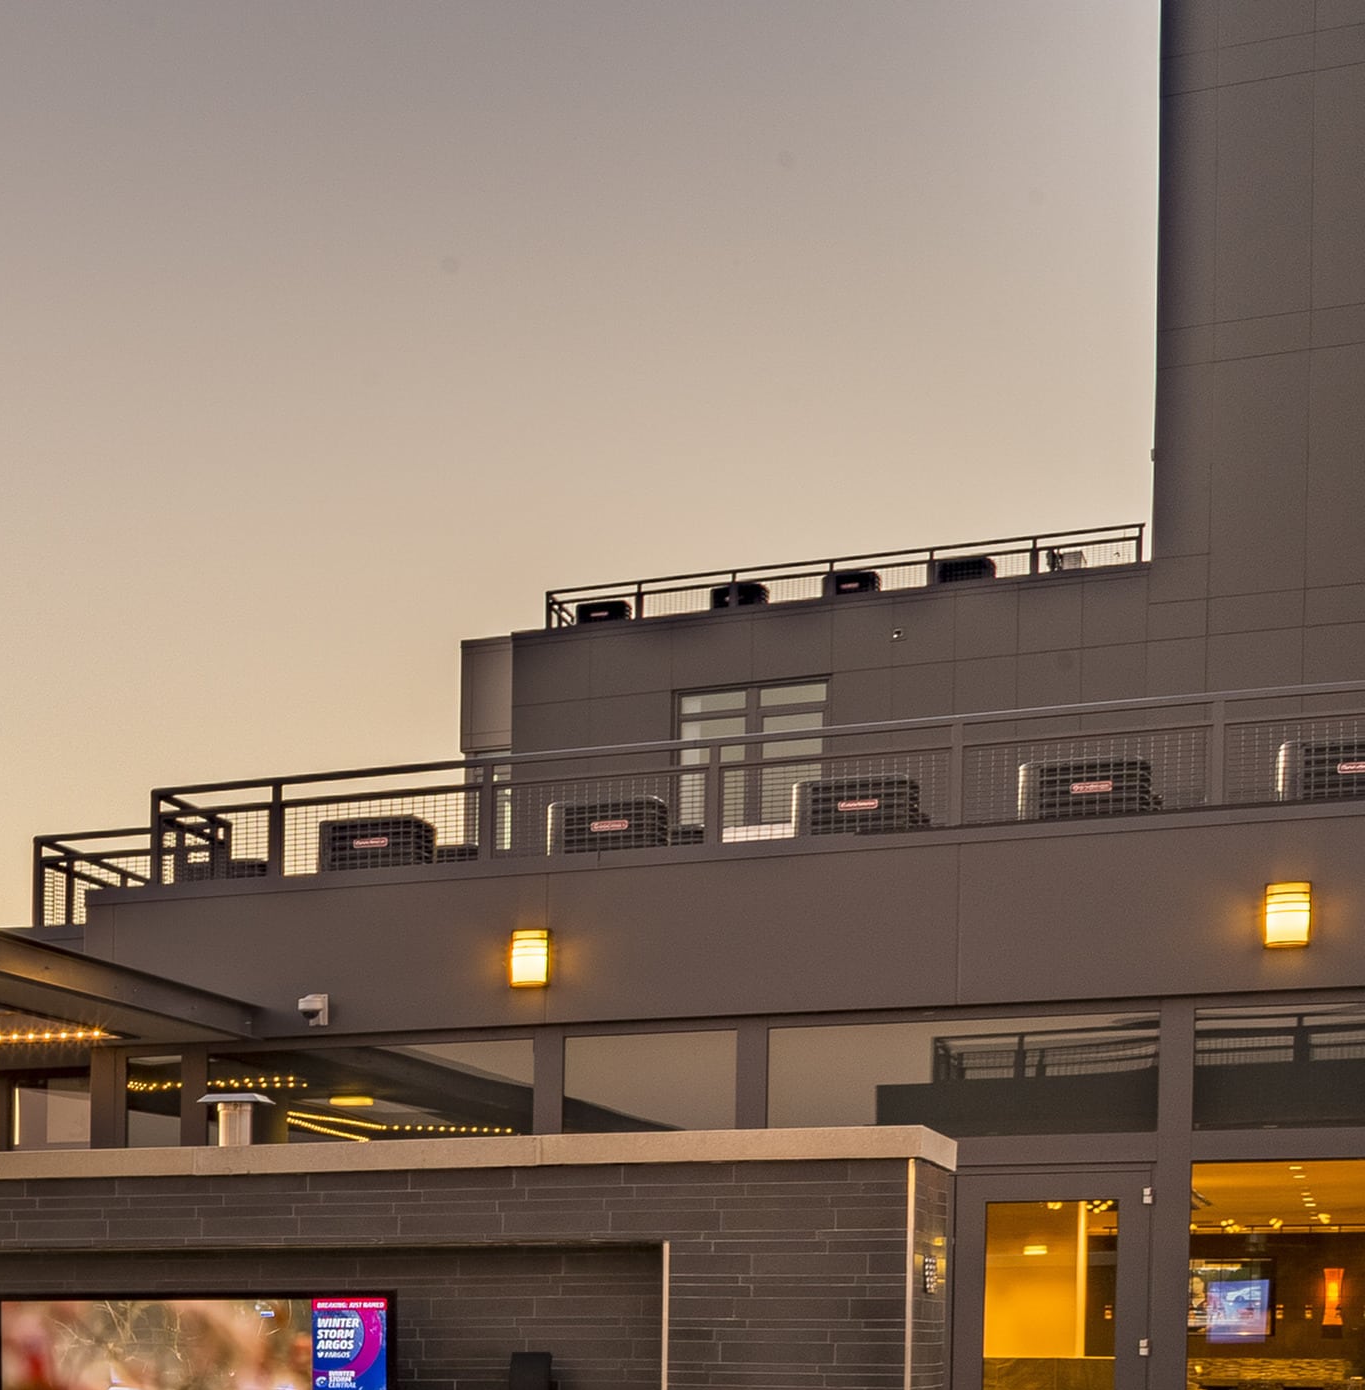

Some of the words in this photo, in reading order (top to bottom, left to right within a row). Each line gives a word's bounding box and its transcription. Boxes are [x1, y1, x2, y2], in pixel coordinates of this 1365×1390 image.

[317, 1317, 360, 1328] WINTER
[316, 1329, 355, 1339] STORM
[316, 1340, 354, 1350] ARGOS
